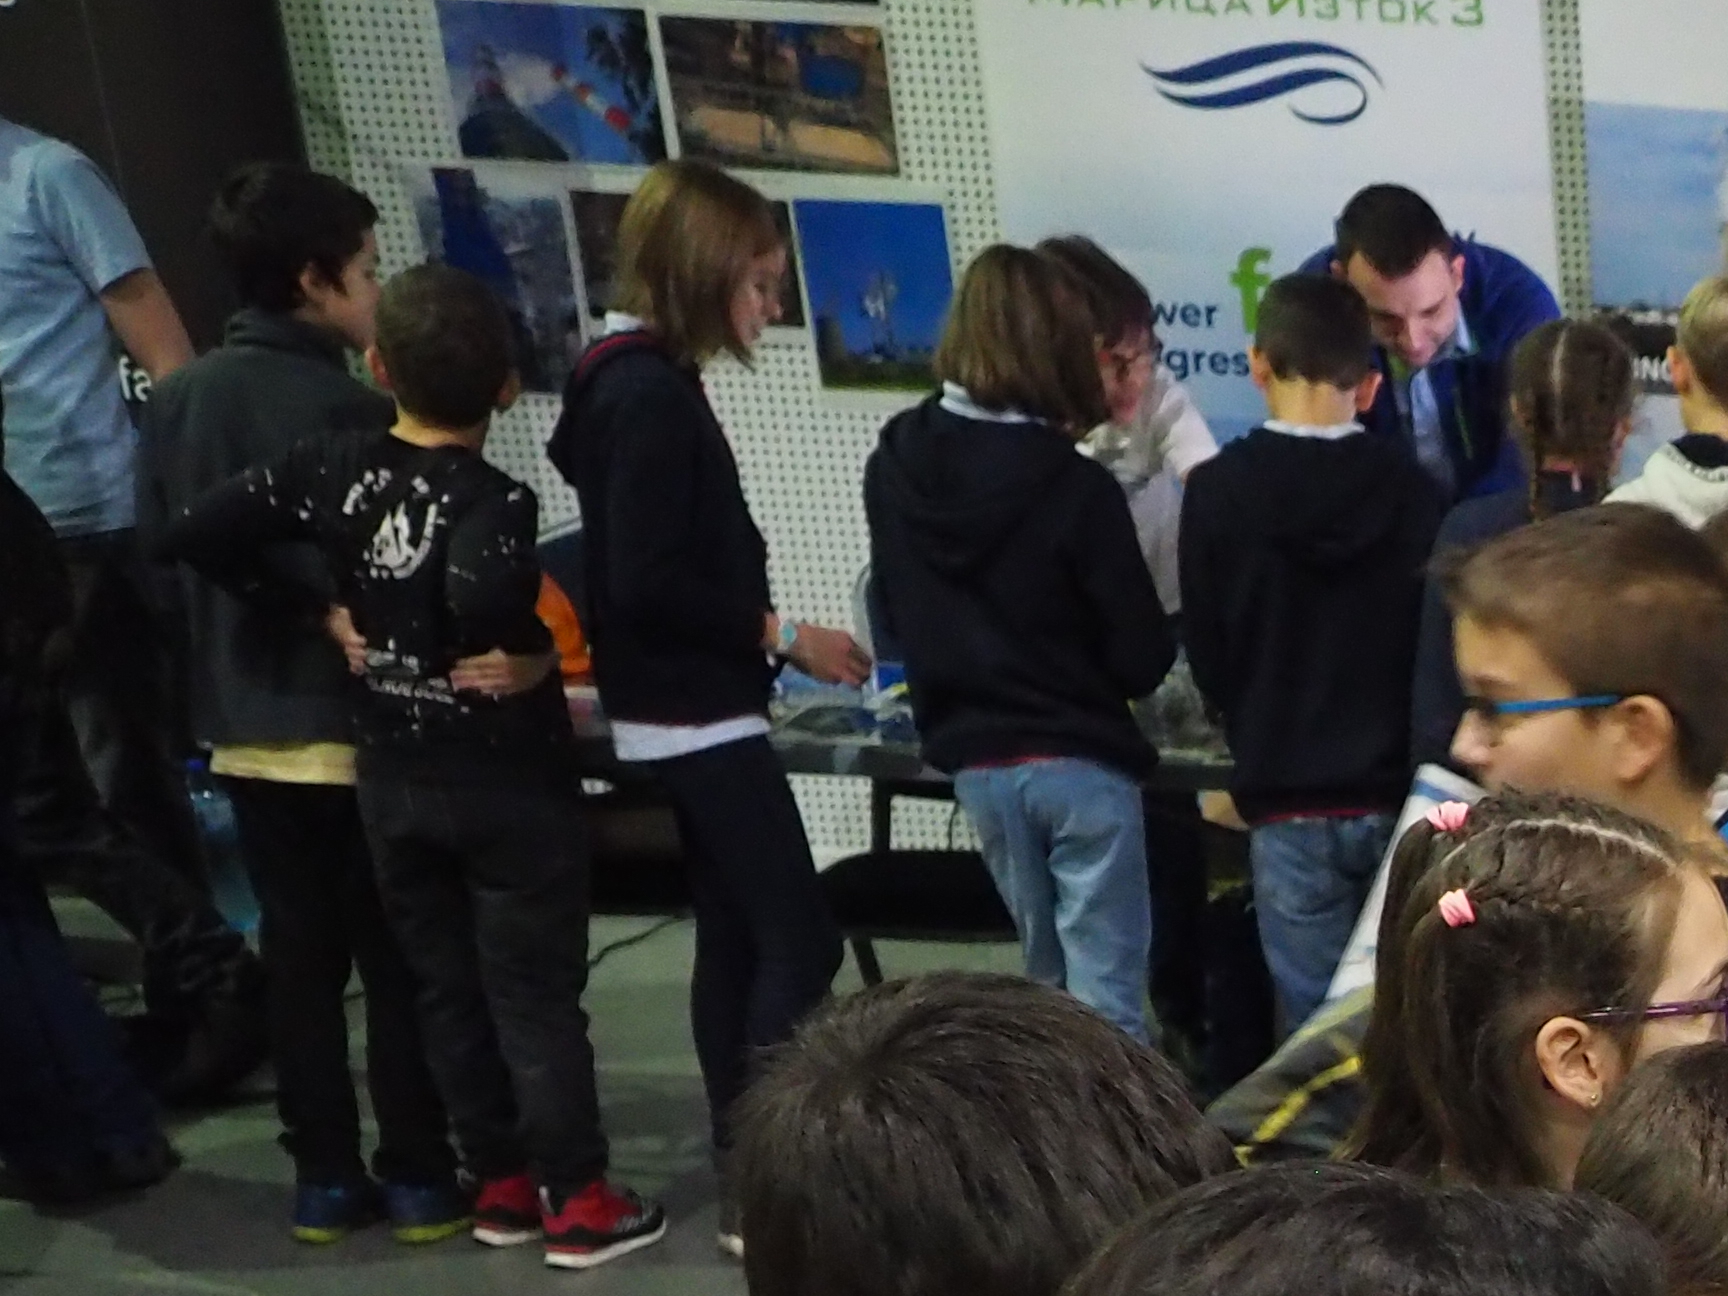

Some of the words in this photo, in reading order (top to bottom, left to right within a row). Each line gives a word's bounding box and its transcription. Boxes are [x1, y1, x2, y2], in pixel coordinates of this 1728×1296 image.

[1450, 0, 1485, 27] 3
[1152, 303, 1217, 328] wer
[1163, 346, 1251, 381] gres
